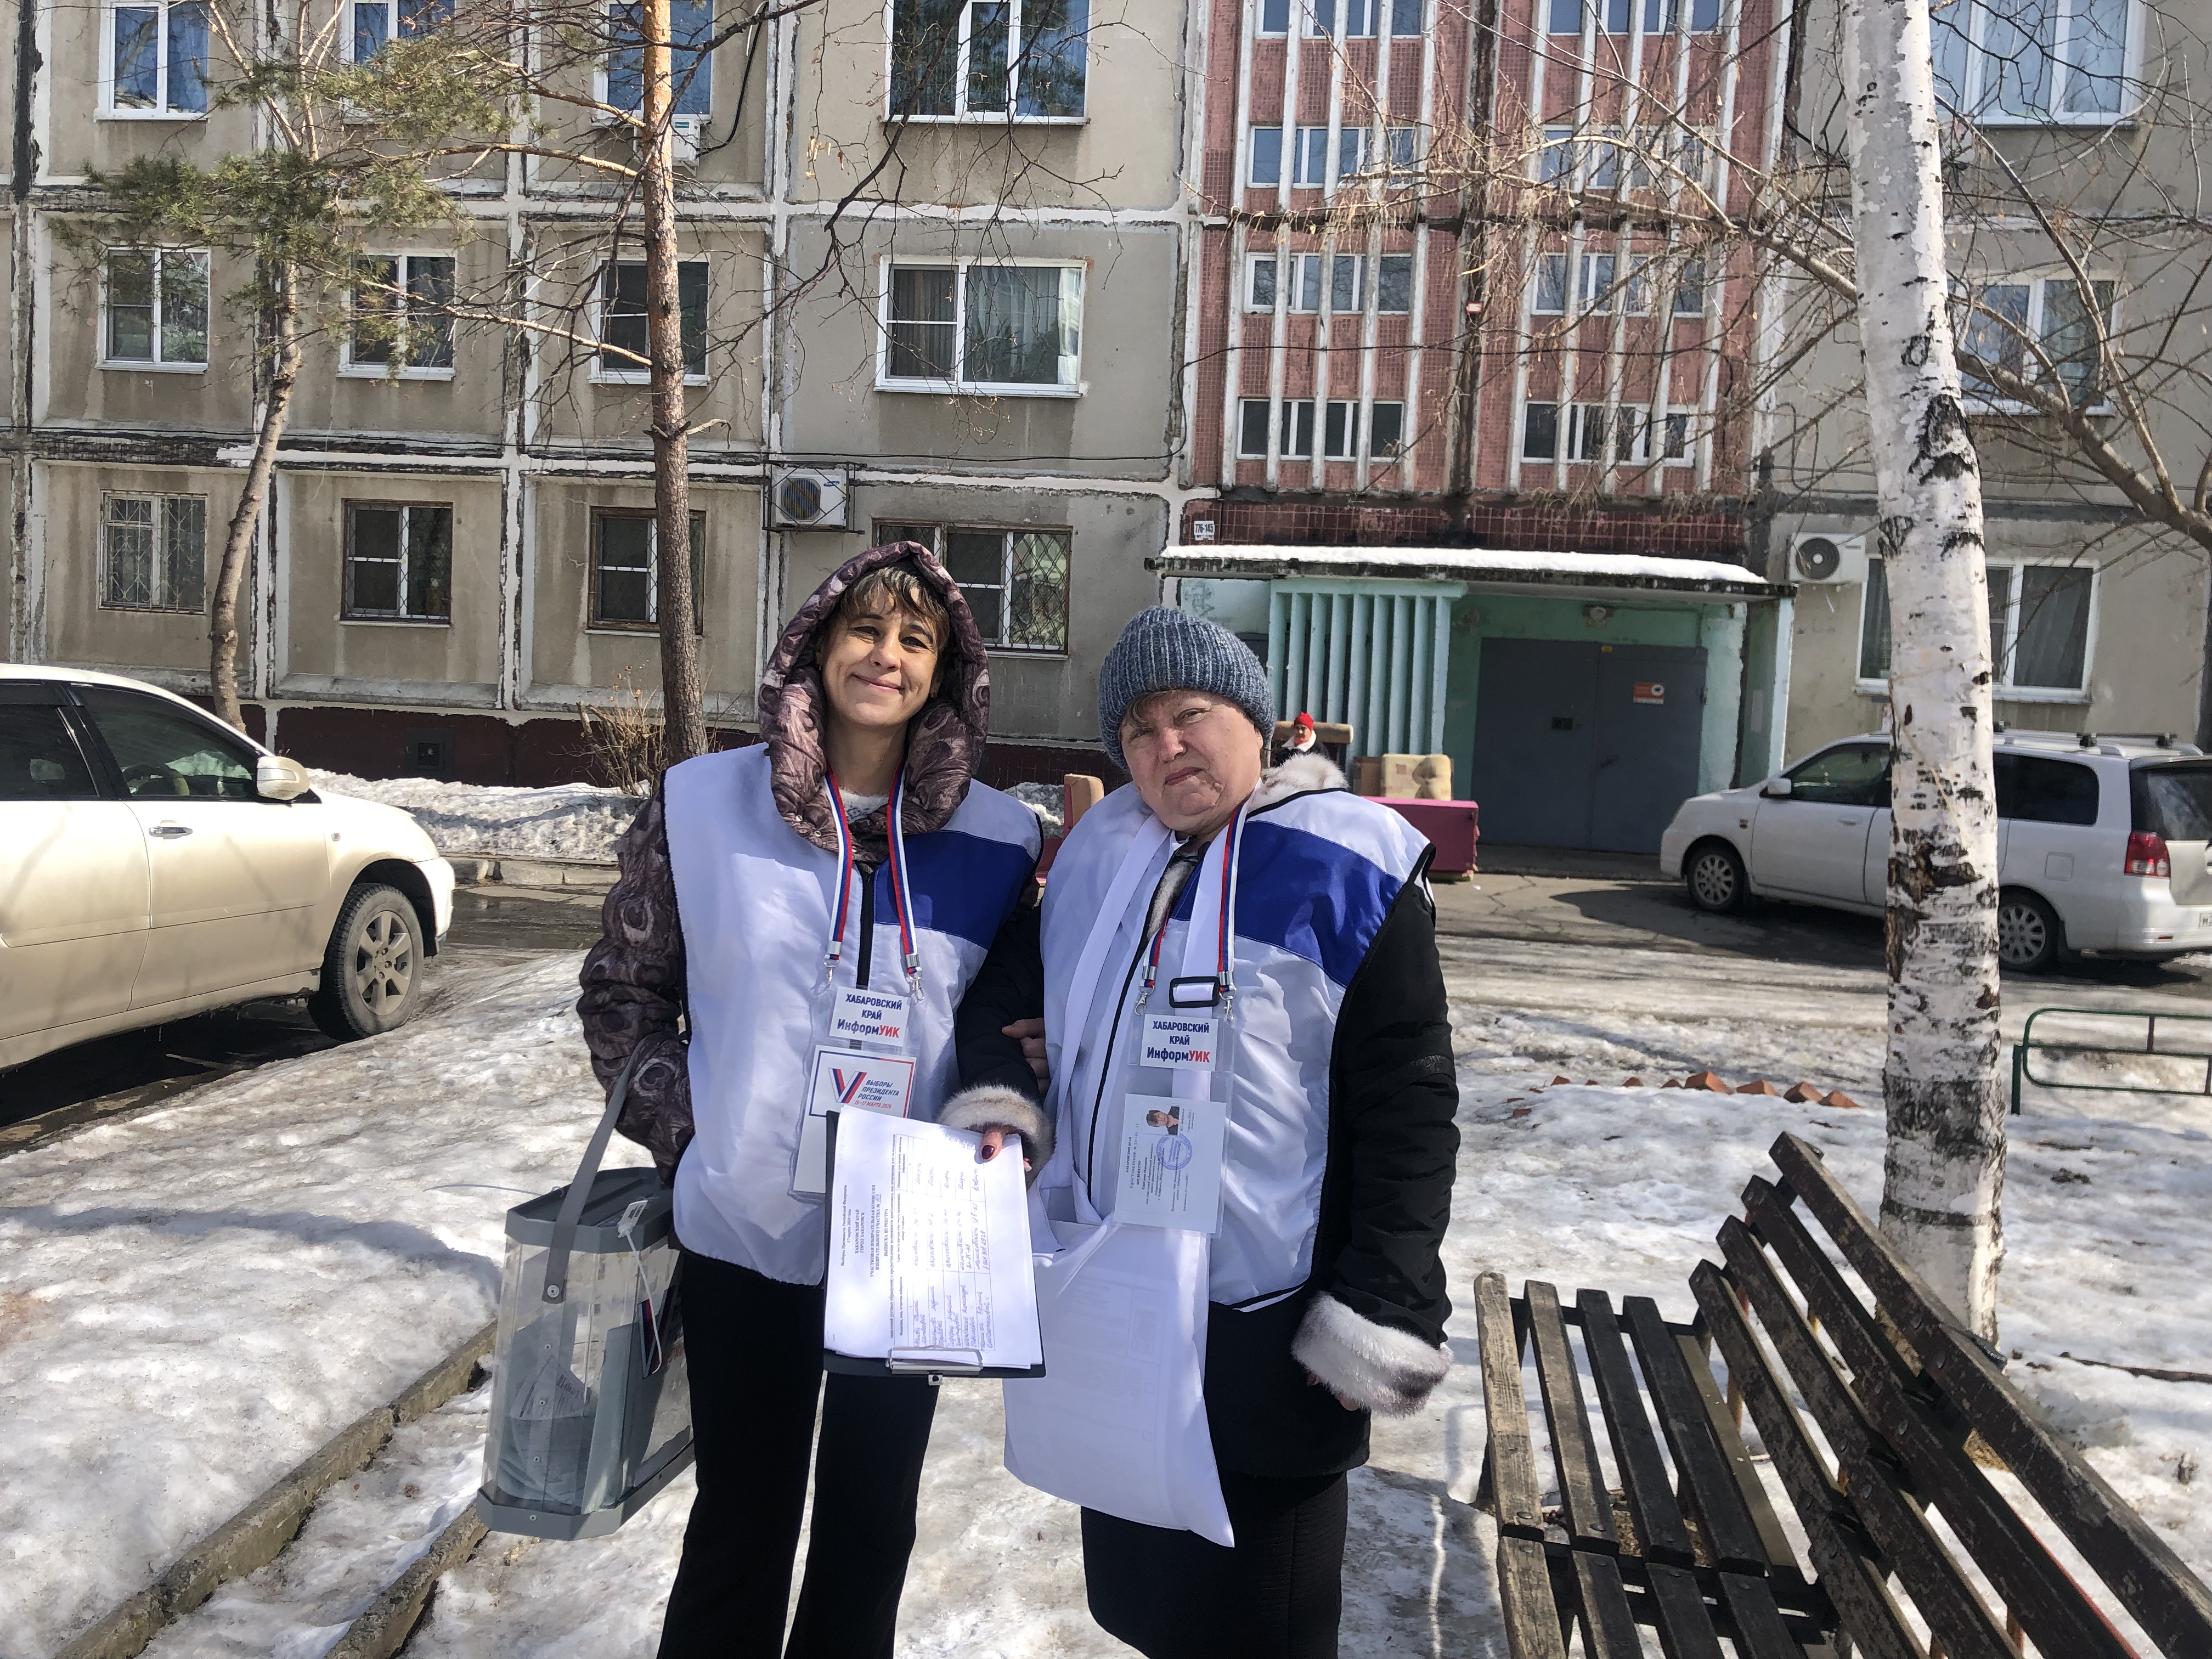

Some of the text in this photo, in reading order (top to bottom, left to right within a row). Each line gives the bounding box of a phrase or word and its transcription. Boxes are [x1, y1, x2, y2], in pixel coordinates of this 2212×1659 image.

[1195, 523, 1213, 533] 776-145
[845, 994, 902, 1010] ХАБАРОВСКИЙ
[861, 1009, 882, 1020] КРАЙ
[837, 1018, 901, 1038] ИнформУИК
[1153, 1020, 1210, 1033] ХАБАРОВСКИЙ
[1169, 1035, 1190, 1045] КРАЙ
[1147, 1047, 1210, 1063] ИнформУИК
[866, 1080, 893, 1088] ВЫБОРЫ
[861, 1086, 900, 1096] ПРЕЗИДЕНТА
[857, 1093, 883, 1102] РОССИИ
